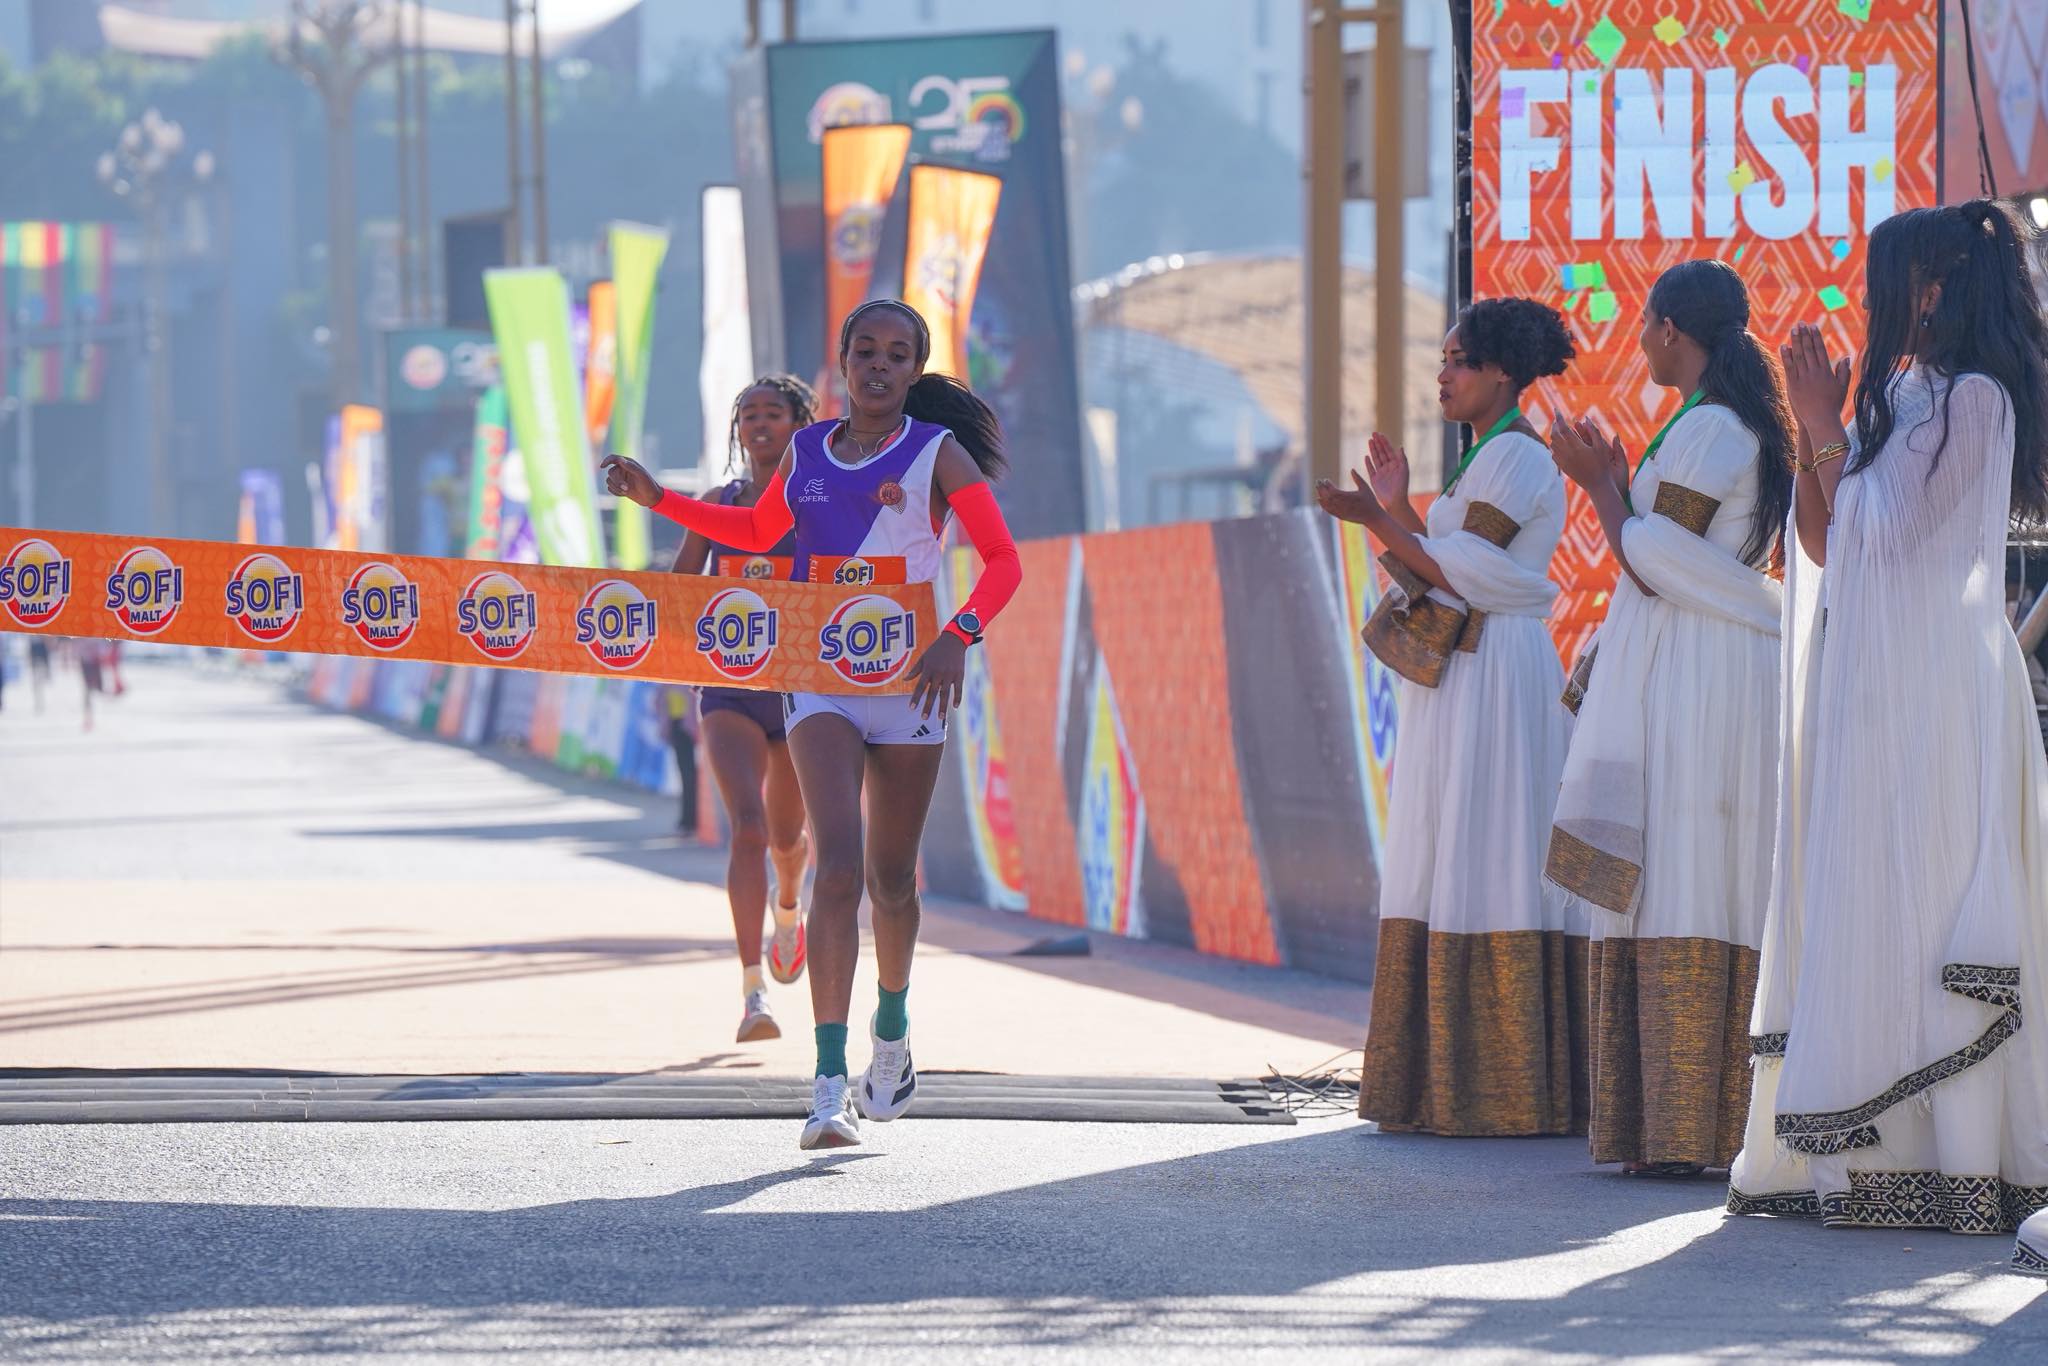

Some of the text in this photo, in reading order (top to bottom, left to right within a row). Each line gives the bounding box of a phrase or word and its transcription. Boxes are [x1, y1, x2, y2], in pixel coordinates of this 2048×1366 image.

[1500, 63, 1896, 241] FINISH
[0, 561, 70, 601] SOFI
[107, 568, 182, 608] SOFI
[834, 565, 874, 584] SOFI
[20, 602, 50, 615] MALT
[226, 575, 303, 615] SOFI
[343, 585, 418, 623] SOFI
[130, 610, 162, 623] MALT
[252, 617, 283, 630] MALT
[458, 593, 536, 633] SOFI
[577, 602, 656, 642] SOFI
[369, 626, 400, 638] MALT
[486, 635, 517, 648] MALT
[696, 610, 776, 652] SOFI
[821, 613, 914, 660] SOFI
[604, 645, 635, 657] MALT
[723, 653, 755, 667] MALT
[852, 659, 891, 675] MALT
